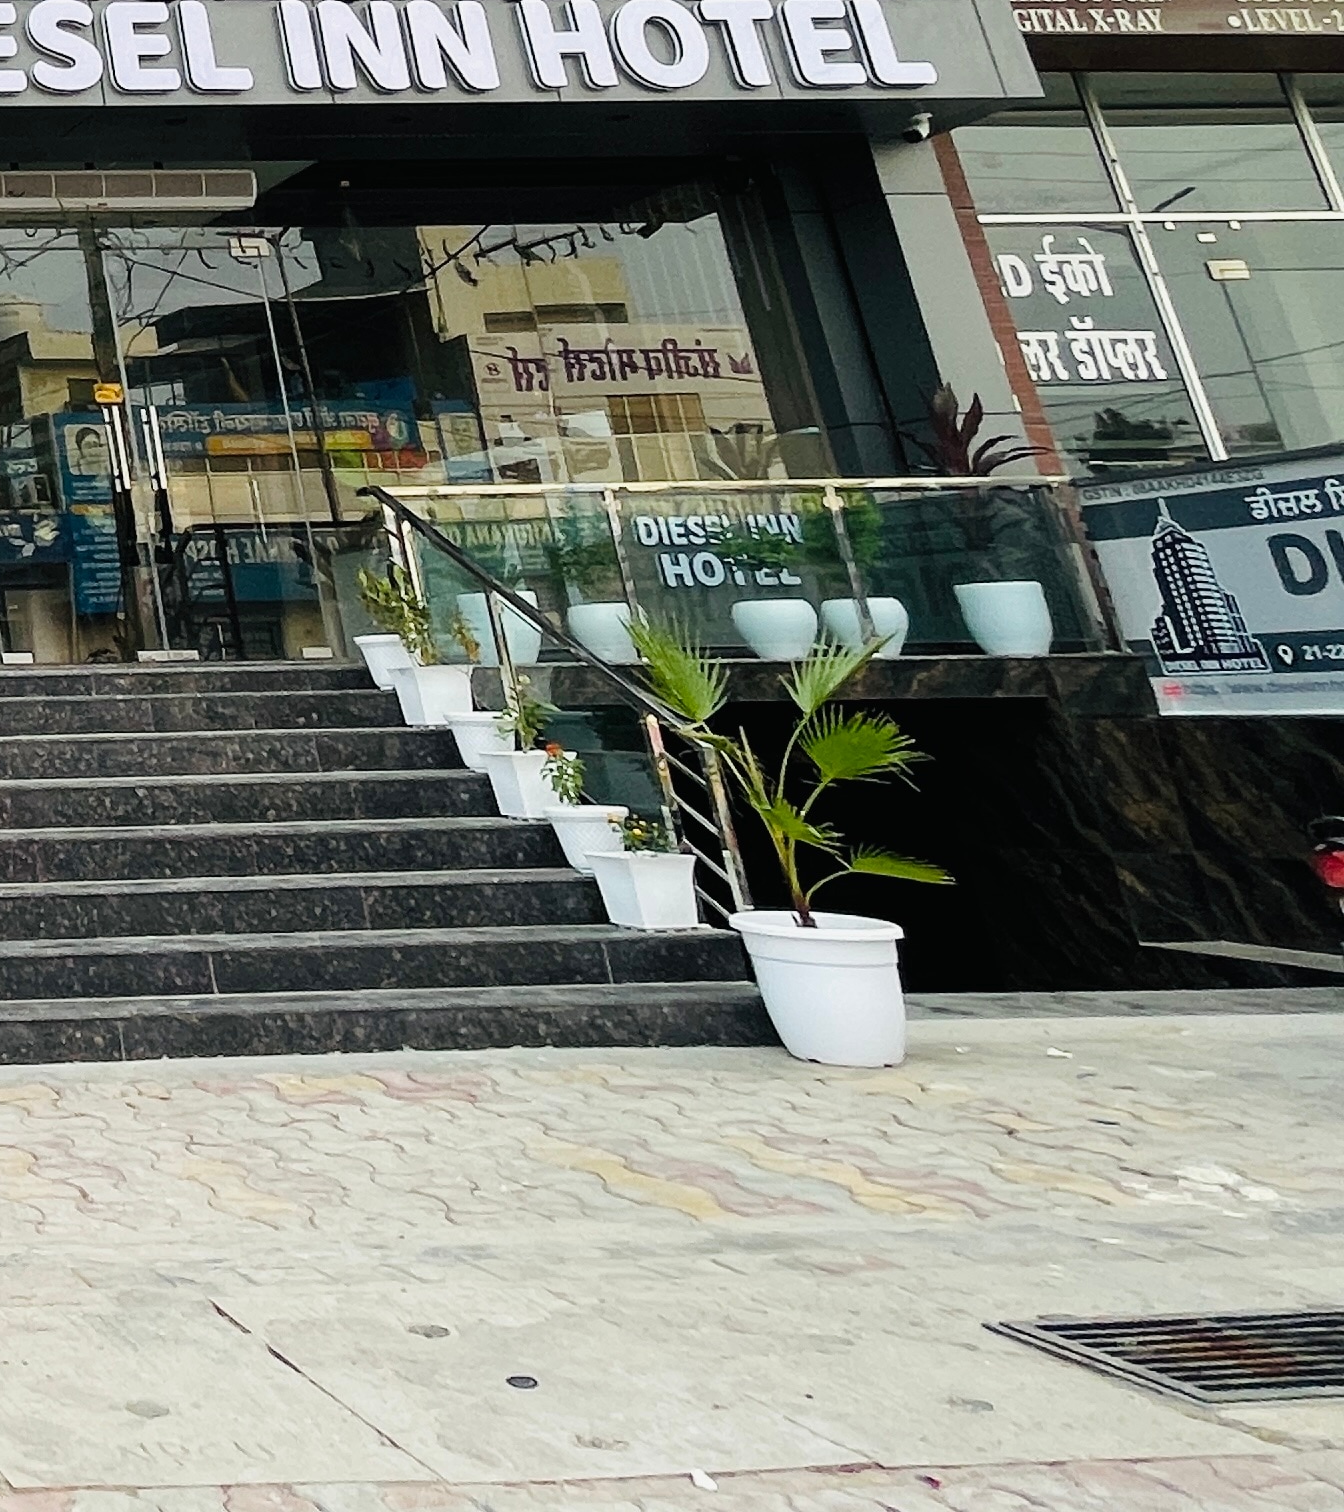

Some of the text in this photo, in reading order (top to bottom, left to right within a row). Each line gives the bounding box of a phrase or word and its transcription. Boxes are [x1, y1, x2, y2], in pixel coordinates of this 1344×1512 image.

[1012, 7, 1164, 33] GITAL X-RAY
[1239, 8, 1323, 32] LEVEL
[994, 234, 1114, 305] D ईको
[1016, 316, 1168, 381] लर डॉप्लर
[1265, 529, 1344, 596] DI
